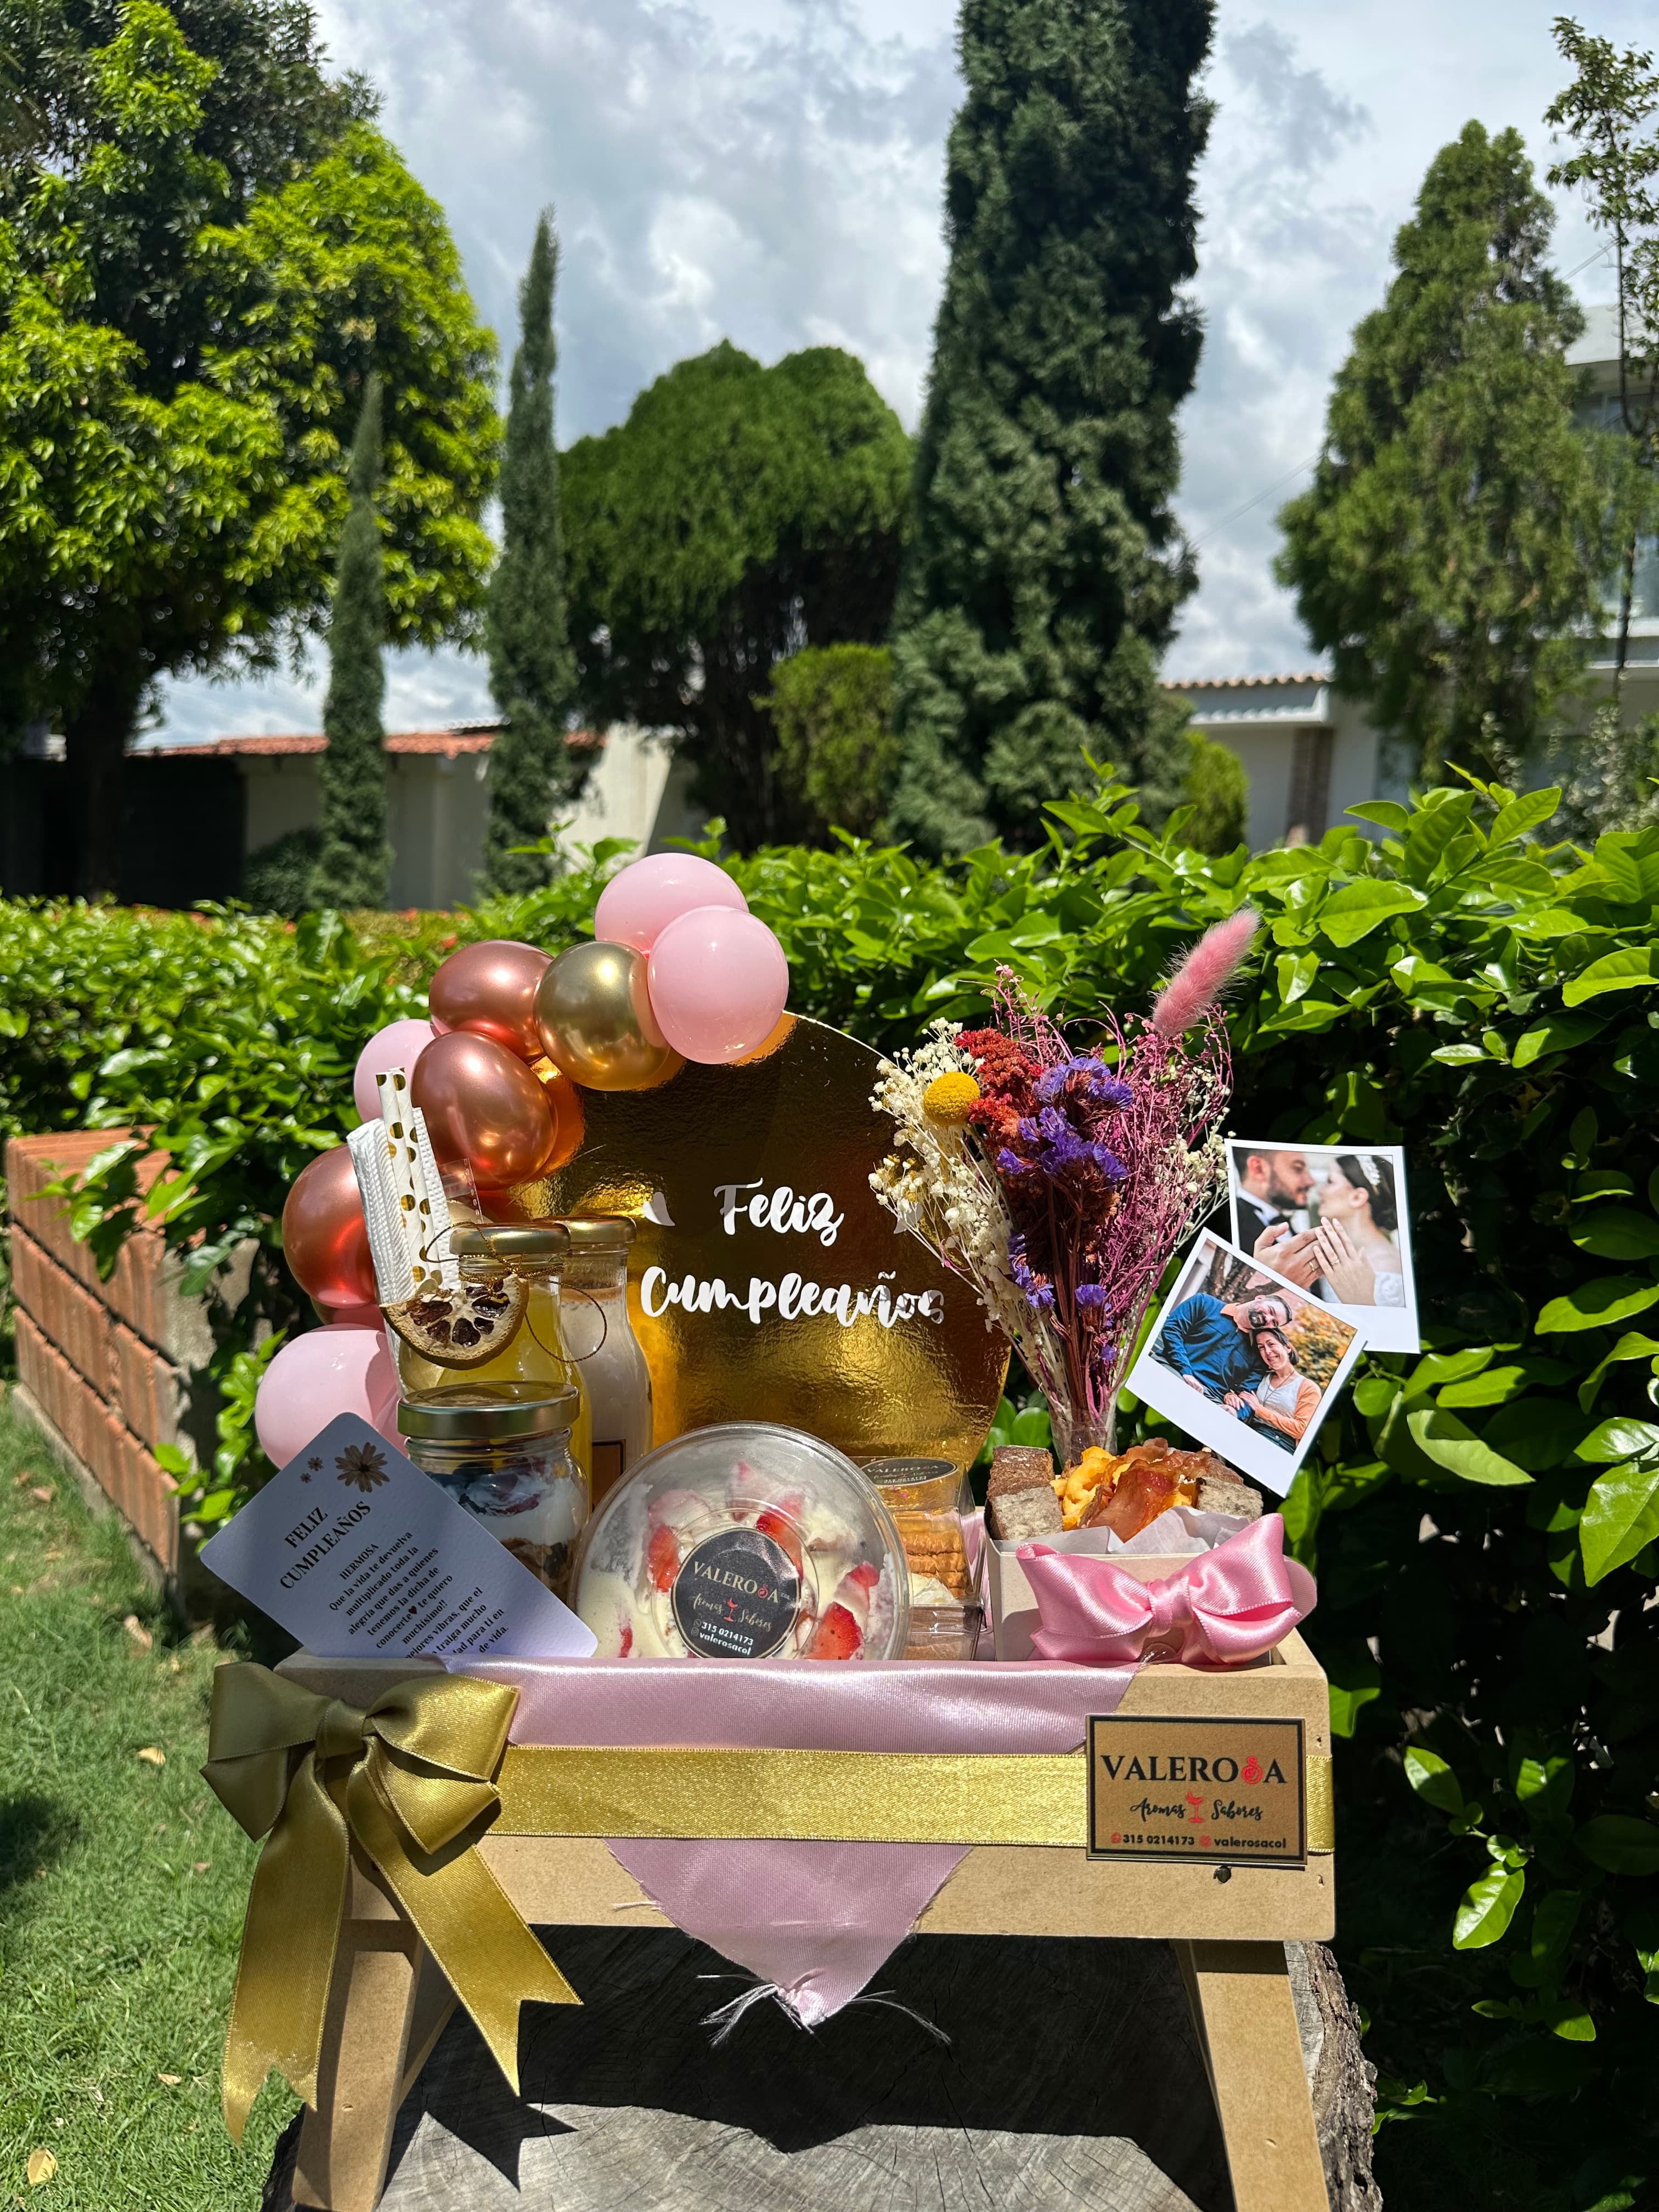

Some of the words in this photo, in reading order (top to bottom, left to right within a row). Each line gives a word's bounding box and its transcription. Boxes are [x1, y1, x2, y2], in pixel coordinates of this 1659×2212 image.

[714, 1177, 844, 1246] Feliz
[641, 1266, 944, 1328] Cumpleaños
[280, 1501, 371, 1589] CUMPLEAÑOS
[284, 1506, 329, 1548] FELIZ
[329, 1595, 347, 1611] Que
[343, 1587, 355, 1597] la
[353, 1573, 371, 1588] vida
[369, 1563, 380, 1573] te
[379, 1531, 413, 1565] devuelva
[339, 1543, 380, 1580] HERMOSA
[346, 1571, 392, 1617] multiplicado
[390, 1555, 411, 1573] toda
[407, 1545, 419, 1556] la
[374, 1594, 390, 1611] que
[388, 1581, 404, 1596] das
[408, 1547, 439, 1578] quienes
[367, 1605, 400, 1637] tenemos
[397, 1596, 409, 1607] la
[407, 1577, 430, 1599] dicha
[428, 1566, 440, 1578] de
[376, 1613, 414, 1649] conocerte
[417, 1598, 428, 1609] te
[427, 1575, 453, 1600] quiero
[432, 1610, 461, 1635] vibras,
[459, 1594, 475, 1612] que
[473, 1587, 483, 1598] el
[436, 1628, 462, 1652] traiga
[460, 1604, 487, 1630] mucho
[467, 1626, 486, 1646] para
[492, 1607, 505, 1620] en
[478, 1641, 490, 1654] de
[489, 1626, 510, 1644] vida.
[699, 1632, 752, 1656] valerosacol
[701, 1621, 717, 1633] 315
[719, 1627, 754, 1646] 0214173
[1130, 1797, 1186, 1822] Aromas
[1211, 1799, 1263, 1821] Sabores
[1122, 1834, 1146, 1844] 315
[1146, 1834, 1195, 1846] 0214173
[1214, 1837, 1286, 1848] valerosacol
